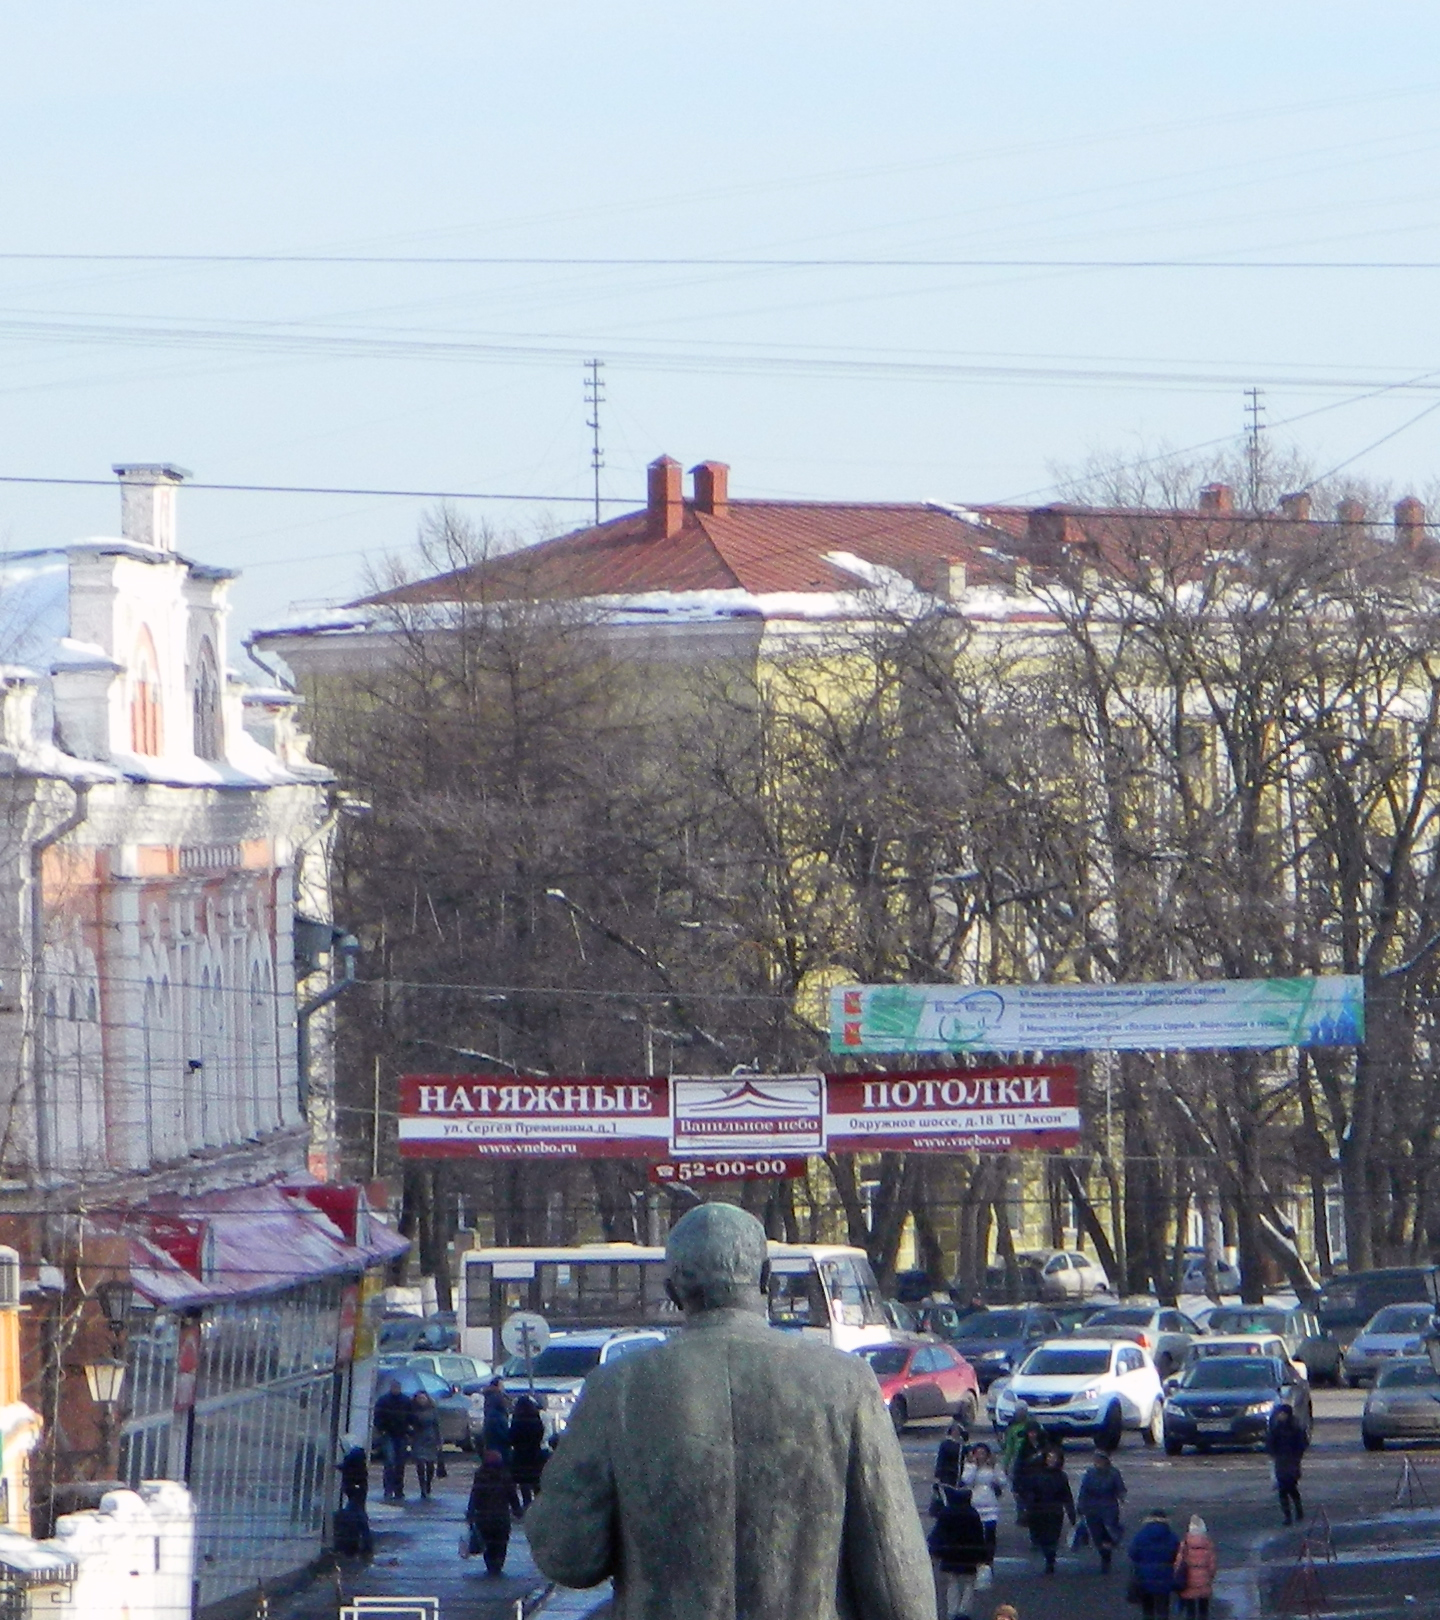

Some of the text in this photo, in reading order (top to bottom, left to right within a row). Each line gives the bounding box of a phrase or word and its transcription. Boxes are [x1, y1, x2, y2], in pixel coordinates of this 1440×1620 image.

[418, 1085, 653, 1112] НАТЯЖНЫЕ
[862, 1076, 1051, 1108] ПОТОЛКИ
[443, 1124, 463, 1135] ул.
[466, 1121, 511, 1135] Сергея
[680, 1118, 819, 1133] Ванильное небо
[849, 1116, 915, 1132] Окружное
[965, 1114, 994, 1128] д.18
[999, 1113, 1015, 1127] ТЦ
[478, 1140, 577, 1154] www.vnebo.ru
[912, 1134, 1011, 1148] www.vnebo.ru
[678, 1159, 787, 1181] 52-00-00
